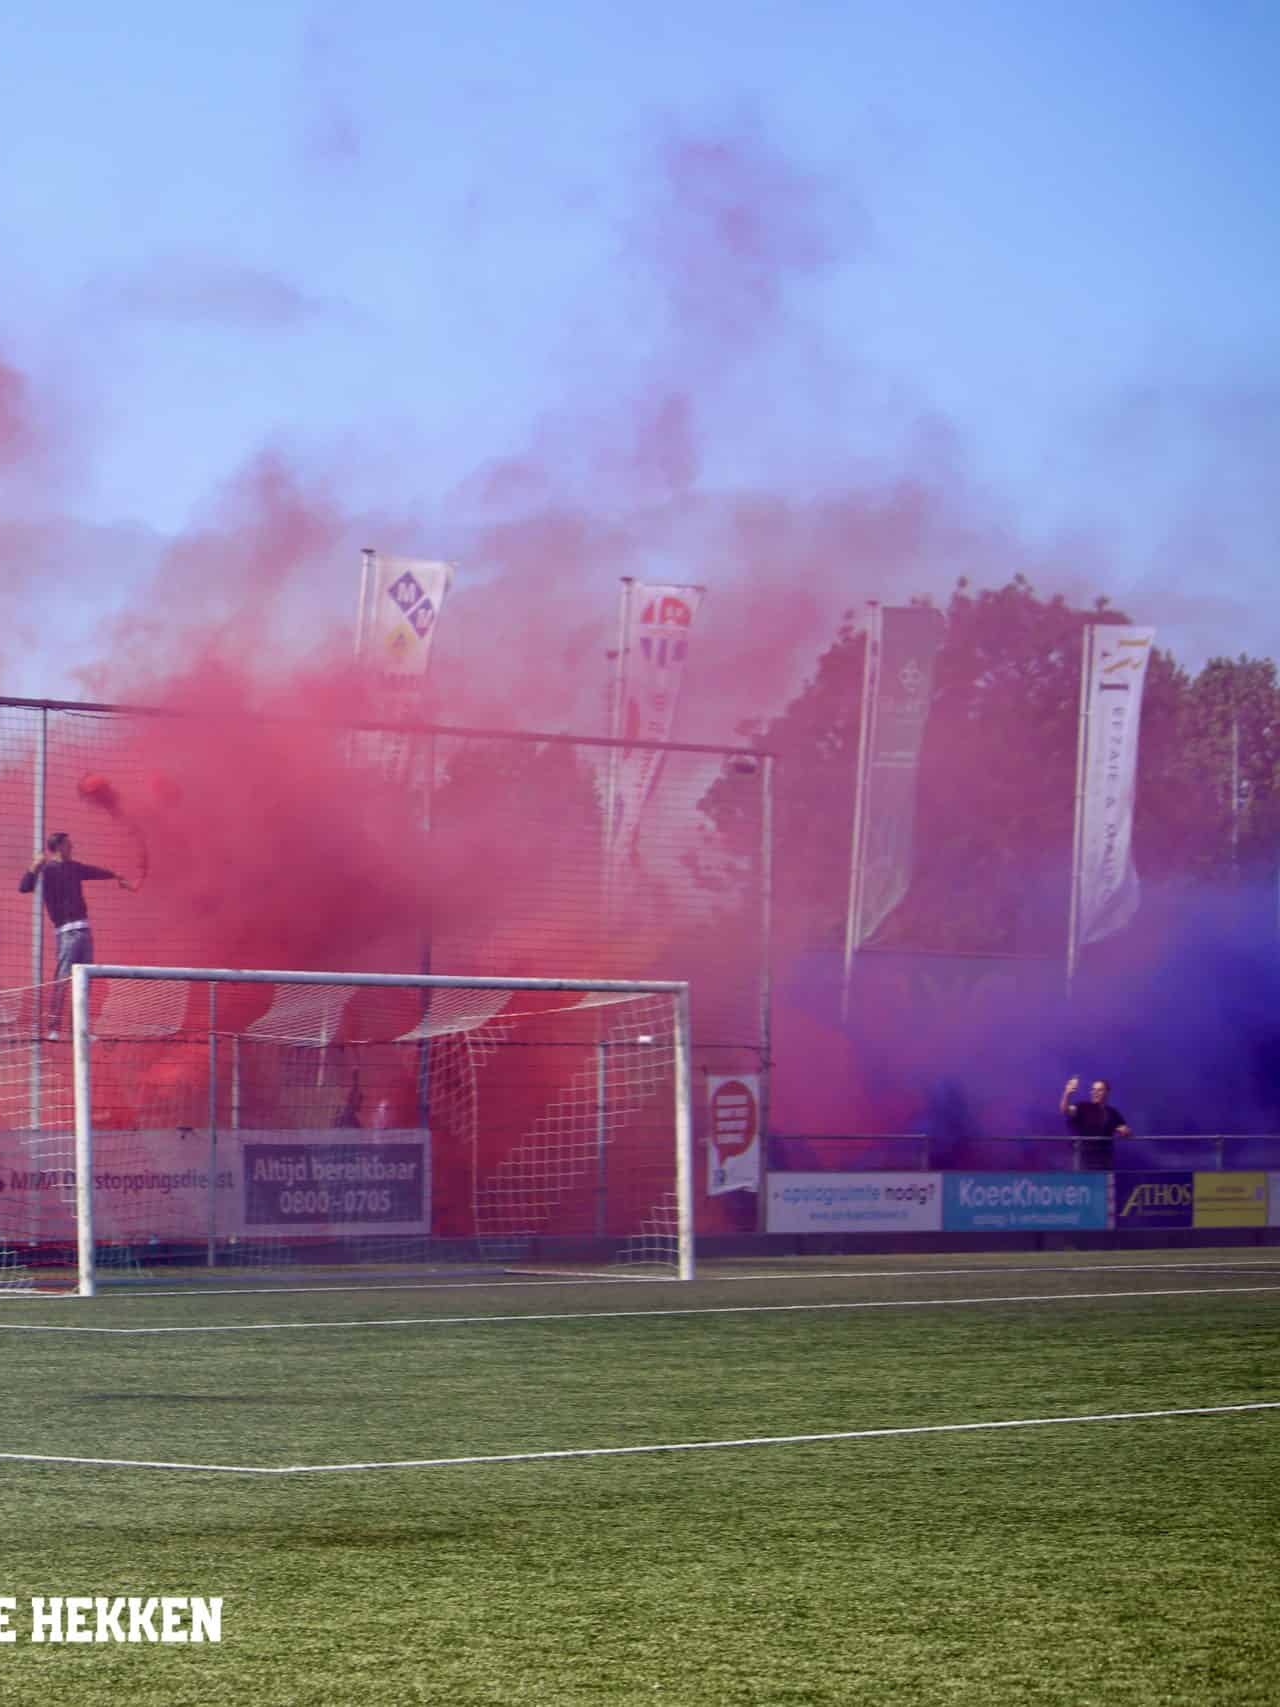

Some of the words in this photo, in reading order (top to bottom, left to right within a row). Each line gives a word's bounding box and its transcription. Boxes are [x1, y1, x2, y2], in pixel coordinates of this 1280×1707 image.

[253, 1156, 307, 1186] Altijd
[311, 1155, 416, 1182] bereikbaar
[1119, 1183, 1193, 1217] ATHOS
